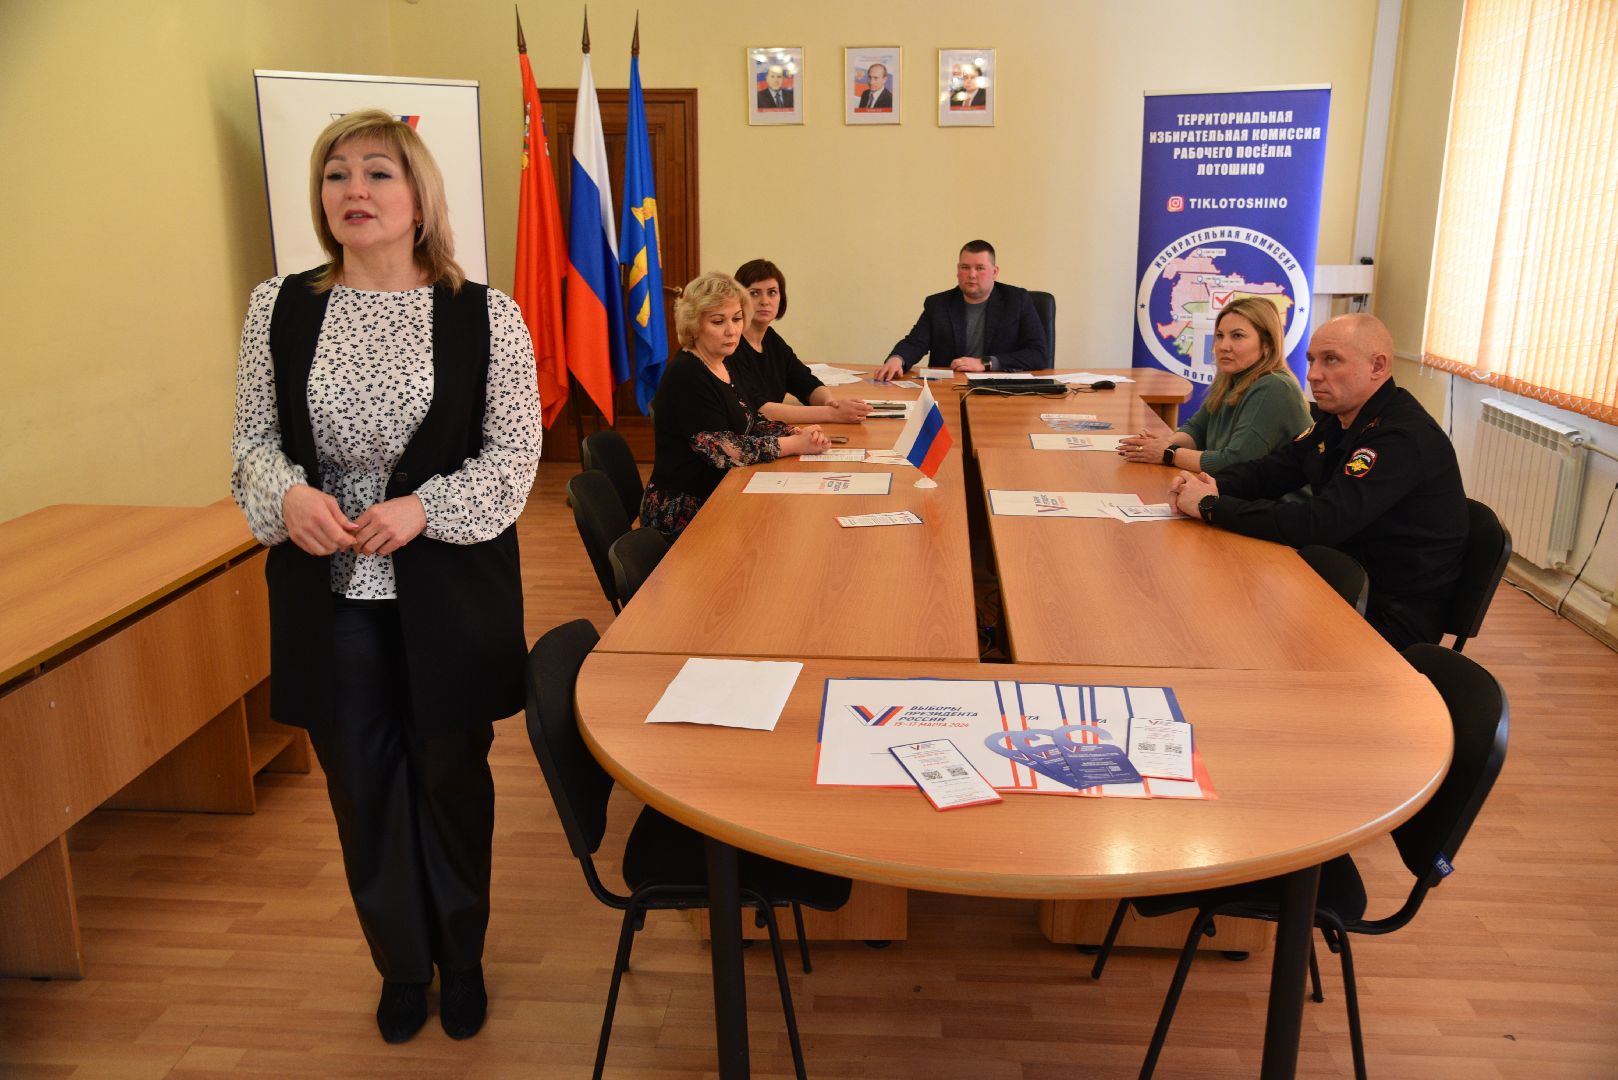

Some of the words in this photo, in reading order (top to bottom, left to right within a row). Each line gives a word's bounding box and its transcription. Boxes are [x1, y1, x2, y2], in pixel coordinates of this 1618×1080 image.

[1177, 111, 1293, 126] ТЕРРИТОРИАЛЬНАЯ
[1149, 129, 1248, 143] ИЗБИРАТЕЛЬНАЯ
[1252, 127, 1321, 141] КОМИССИЯ
[1173, 147, 1232, 159] РАБОЧЕГО
[1236, 144, 1292, 158] ПОСЁЛКА
[1197, 163, 1265, 176] ЛОТОШИНО
[1189, 197, 1288, 209] TIKLOTOSHINO
[1155, 230, 1241, 269] ИЗБИРАТЕЛЬНАЯ
[1245, 231, 1297, 271] КОМИССИЯ
